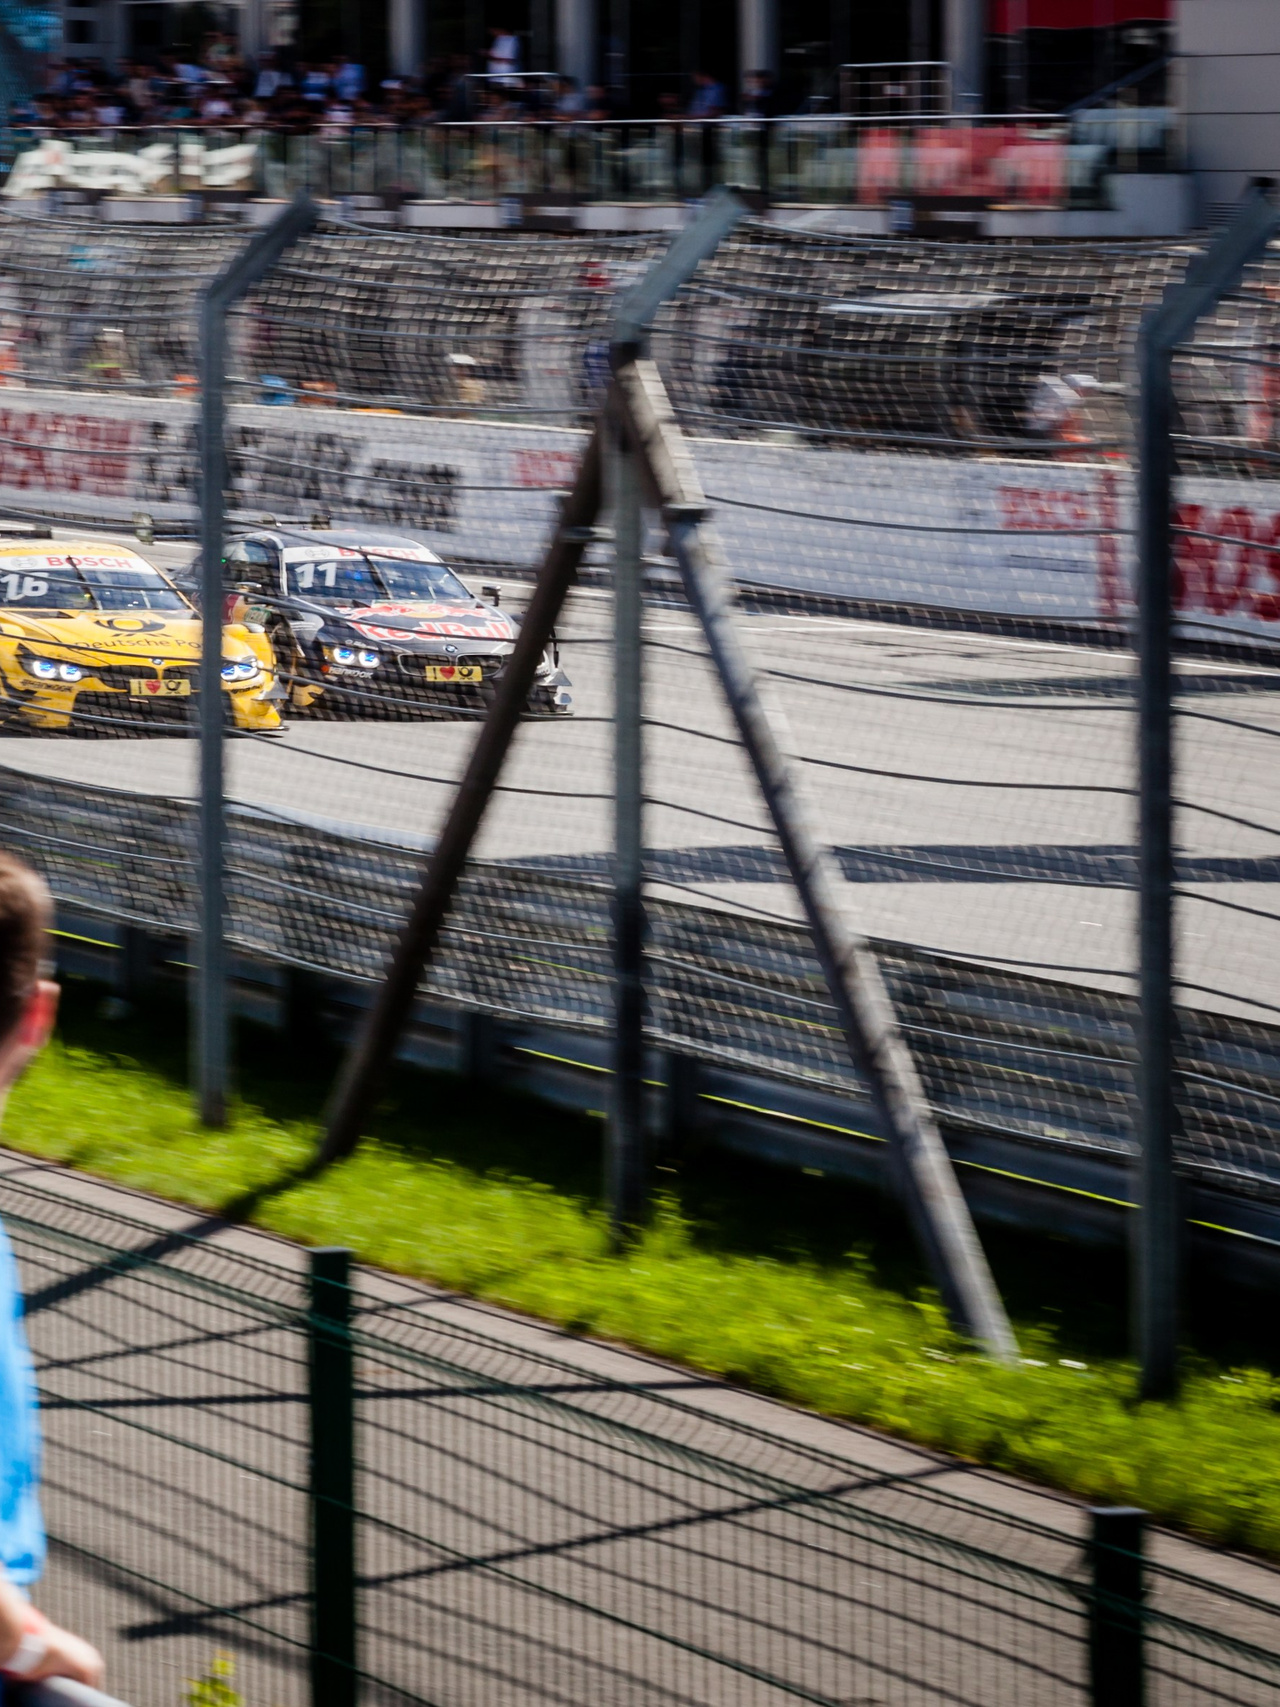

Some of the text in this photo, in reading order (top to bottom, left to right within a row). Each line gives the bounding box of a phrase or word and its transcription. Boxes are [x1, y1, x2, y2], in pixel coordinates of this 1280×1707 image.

[45, 556, 133, 569] BOSCH
[294, 562, 337, 589] 11
[74, 638, 171, 649] Deutsche
